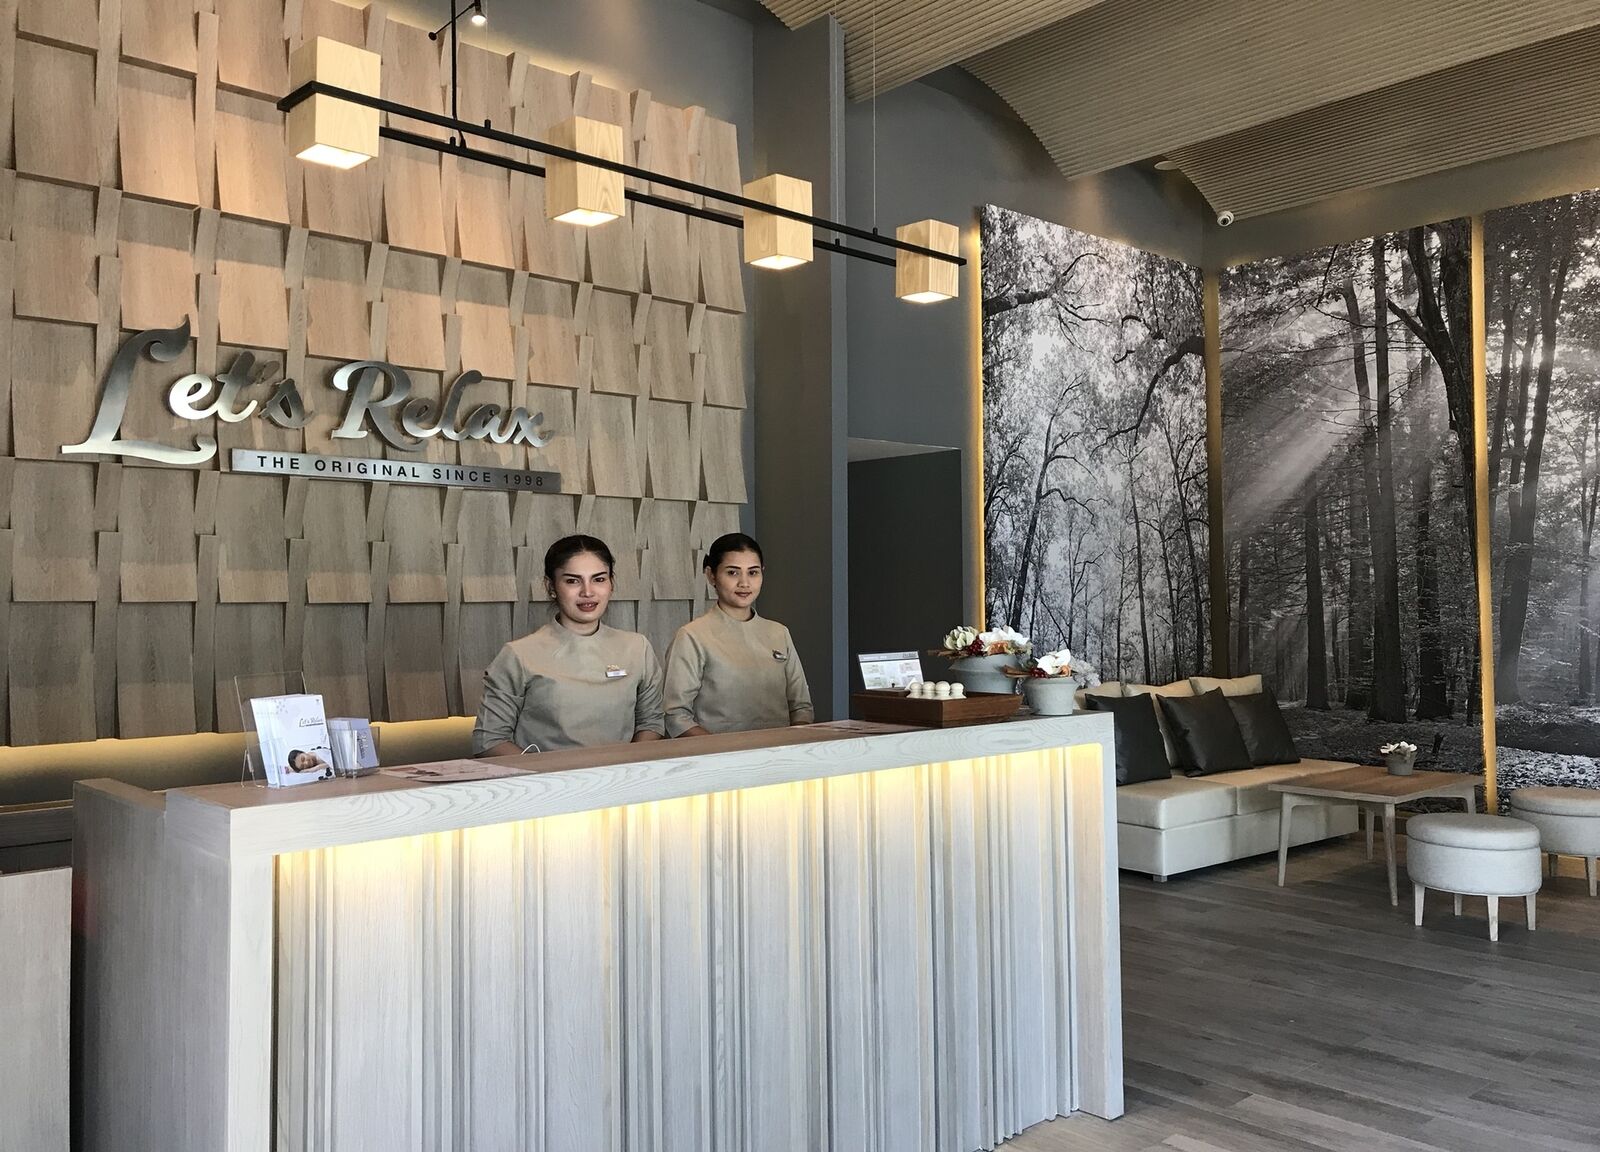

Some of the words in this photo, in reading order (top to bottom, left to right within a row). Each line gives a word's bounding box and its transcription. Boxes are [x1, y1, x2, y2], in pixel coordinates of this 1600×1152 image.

[62, 313, 316, 464] Let's
[331, 361, 555, 451] Relax
[257, 455, 299, 470] THE
[314, 459, 420, 479] ORIGINAL
[433, 468, 491, 483] SINCE
[503, 474, 543, 487] 1998
